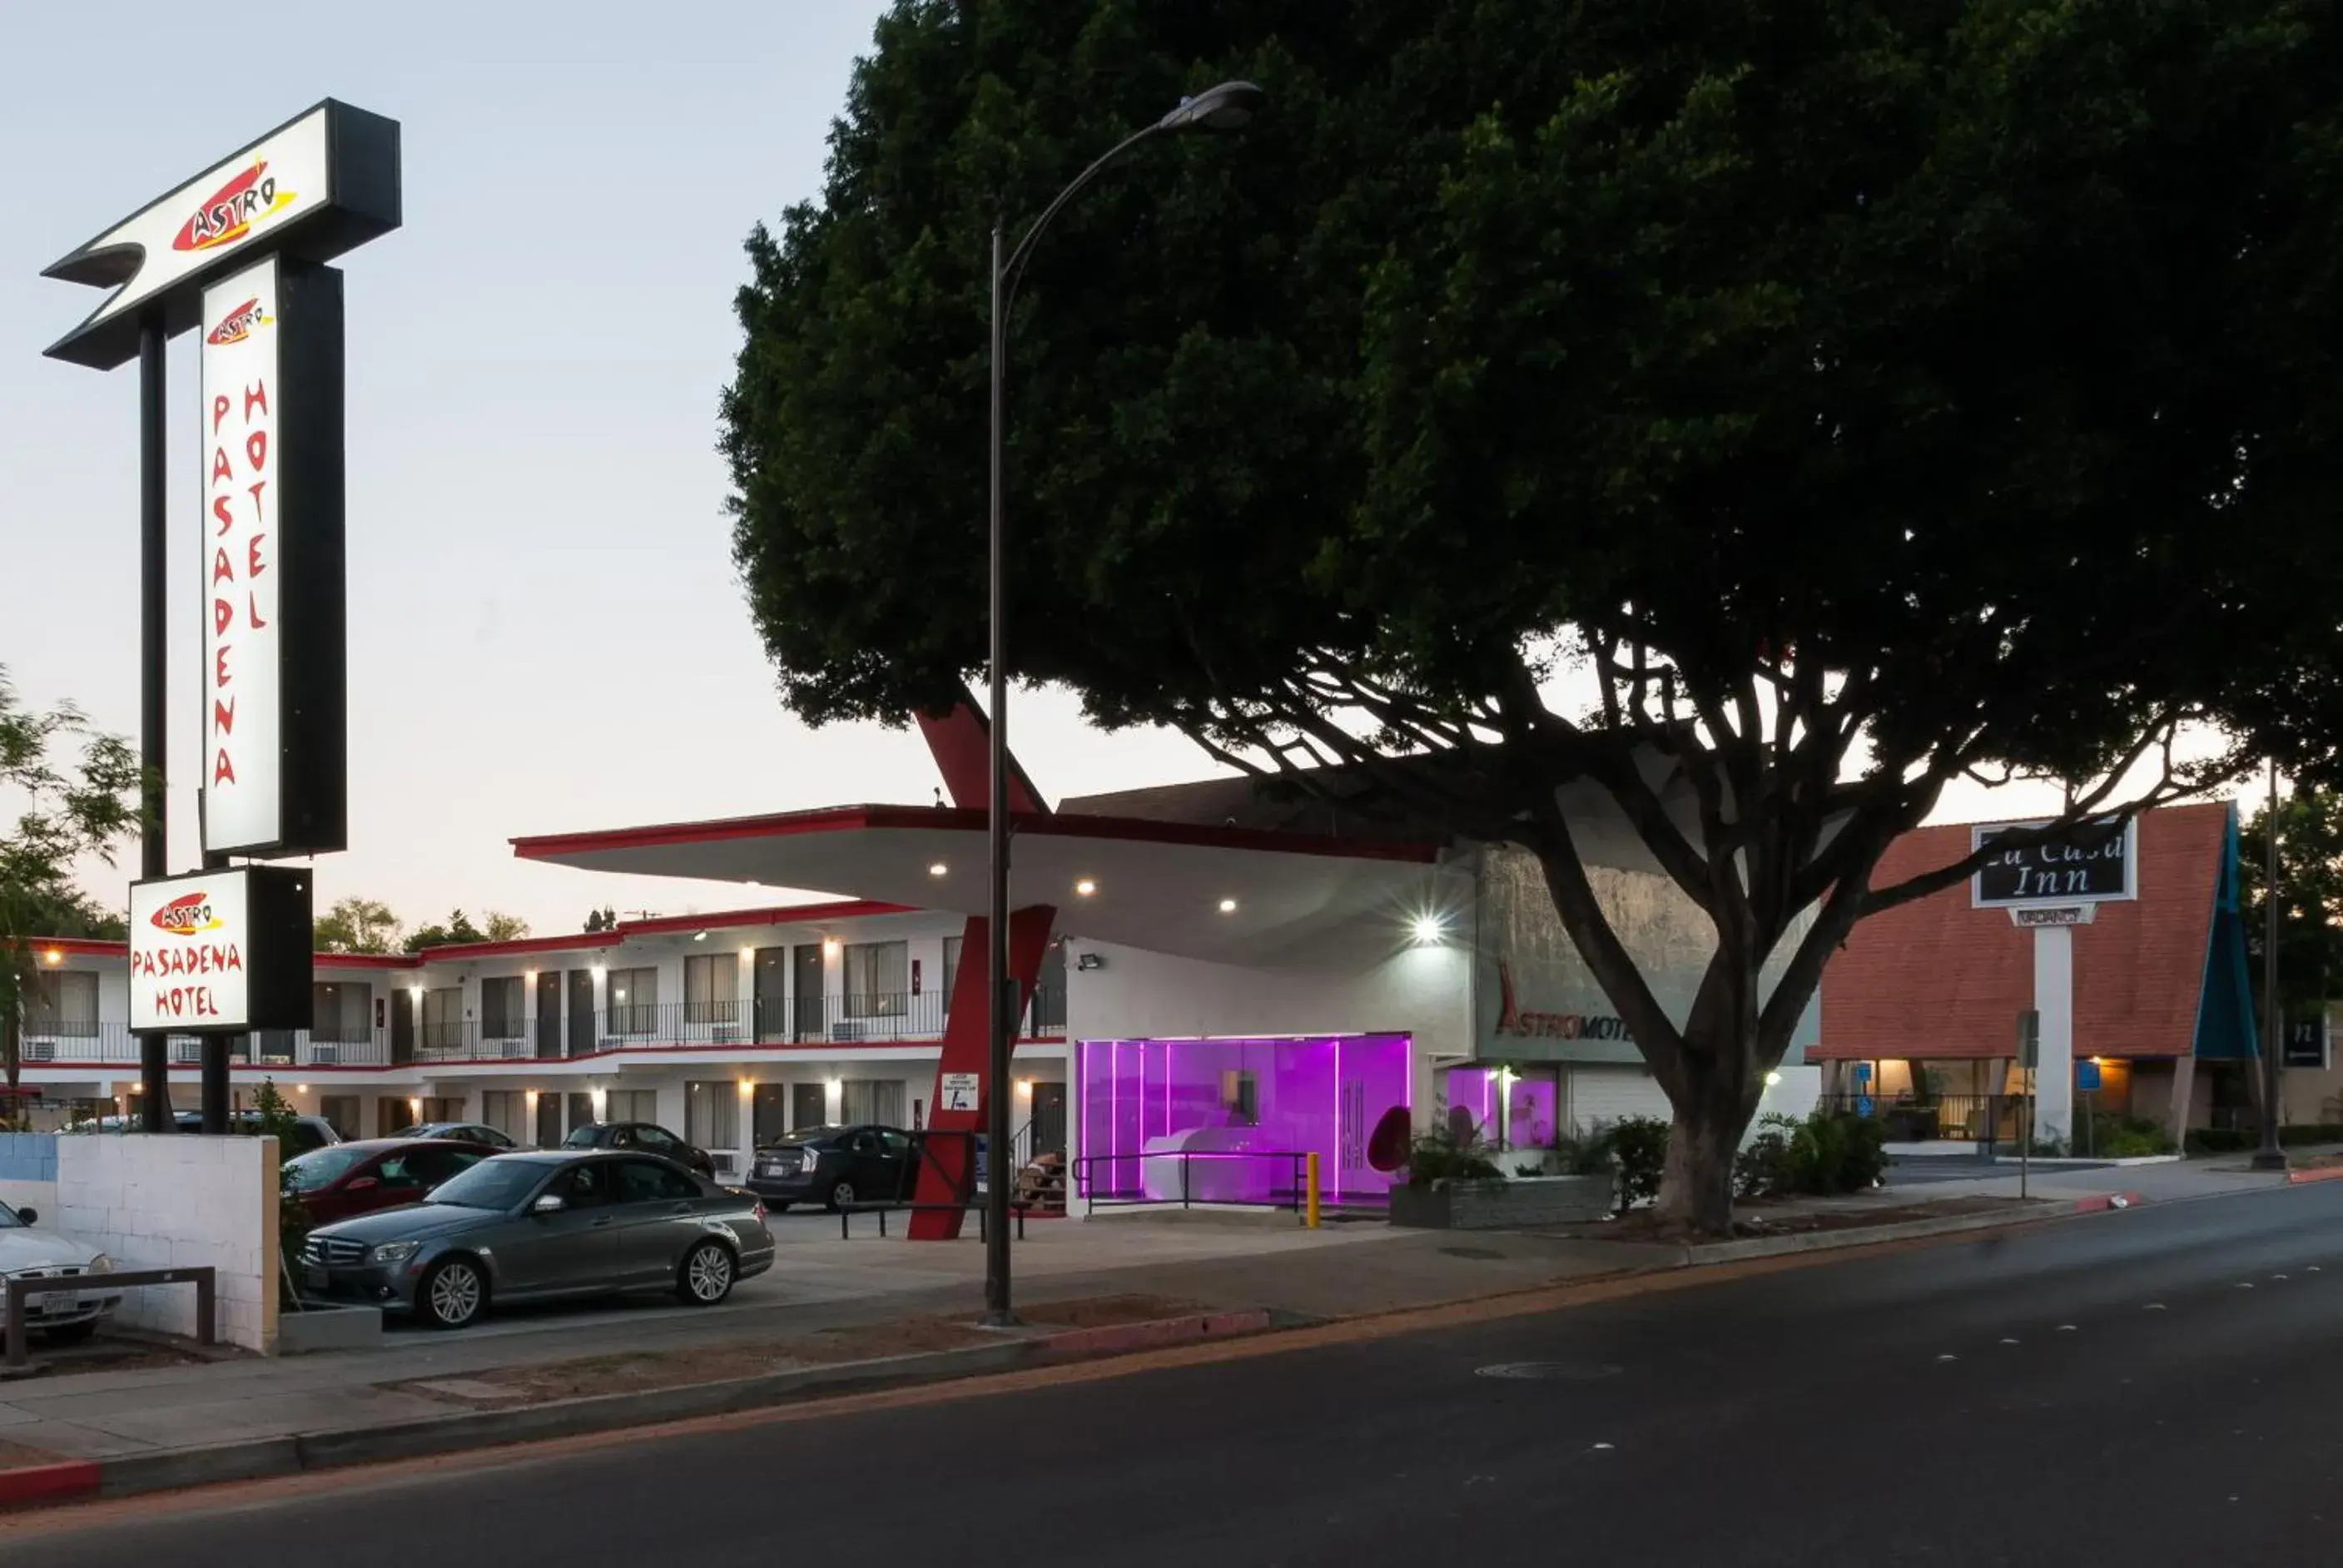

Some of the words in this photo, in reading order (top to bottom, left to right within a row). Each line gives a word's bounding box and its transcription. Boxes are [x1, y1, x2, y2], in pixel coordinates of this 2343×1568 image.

[191, 177, 275, 243] ASTRO
[218, 306, 263, 336] ASTRO
[244, 378, 268, 630] HOTEL
[212, 395, 236, 787] PASADENA
[2013, 866, 2089, 896] Inn
[164, 906, 211, 926] ASTRO
[132, 944, 241, 979] PASADENA
[156, 987, 218, 1016] HOTEL
